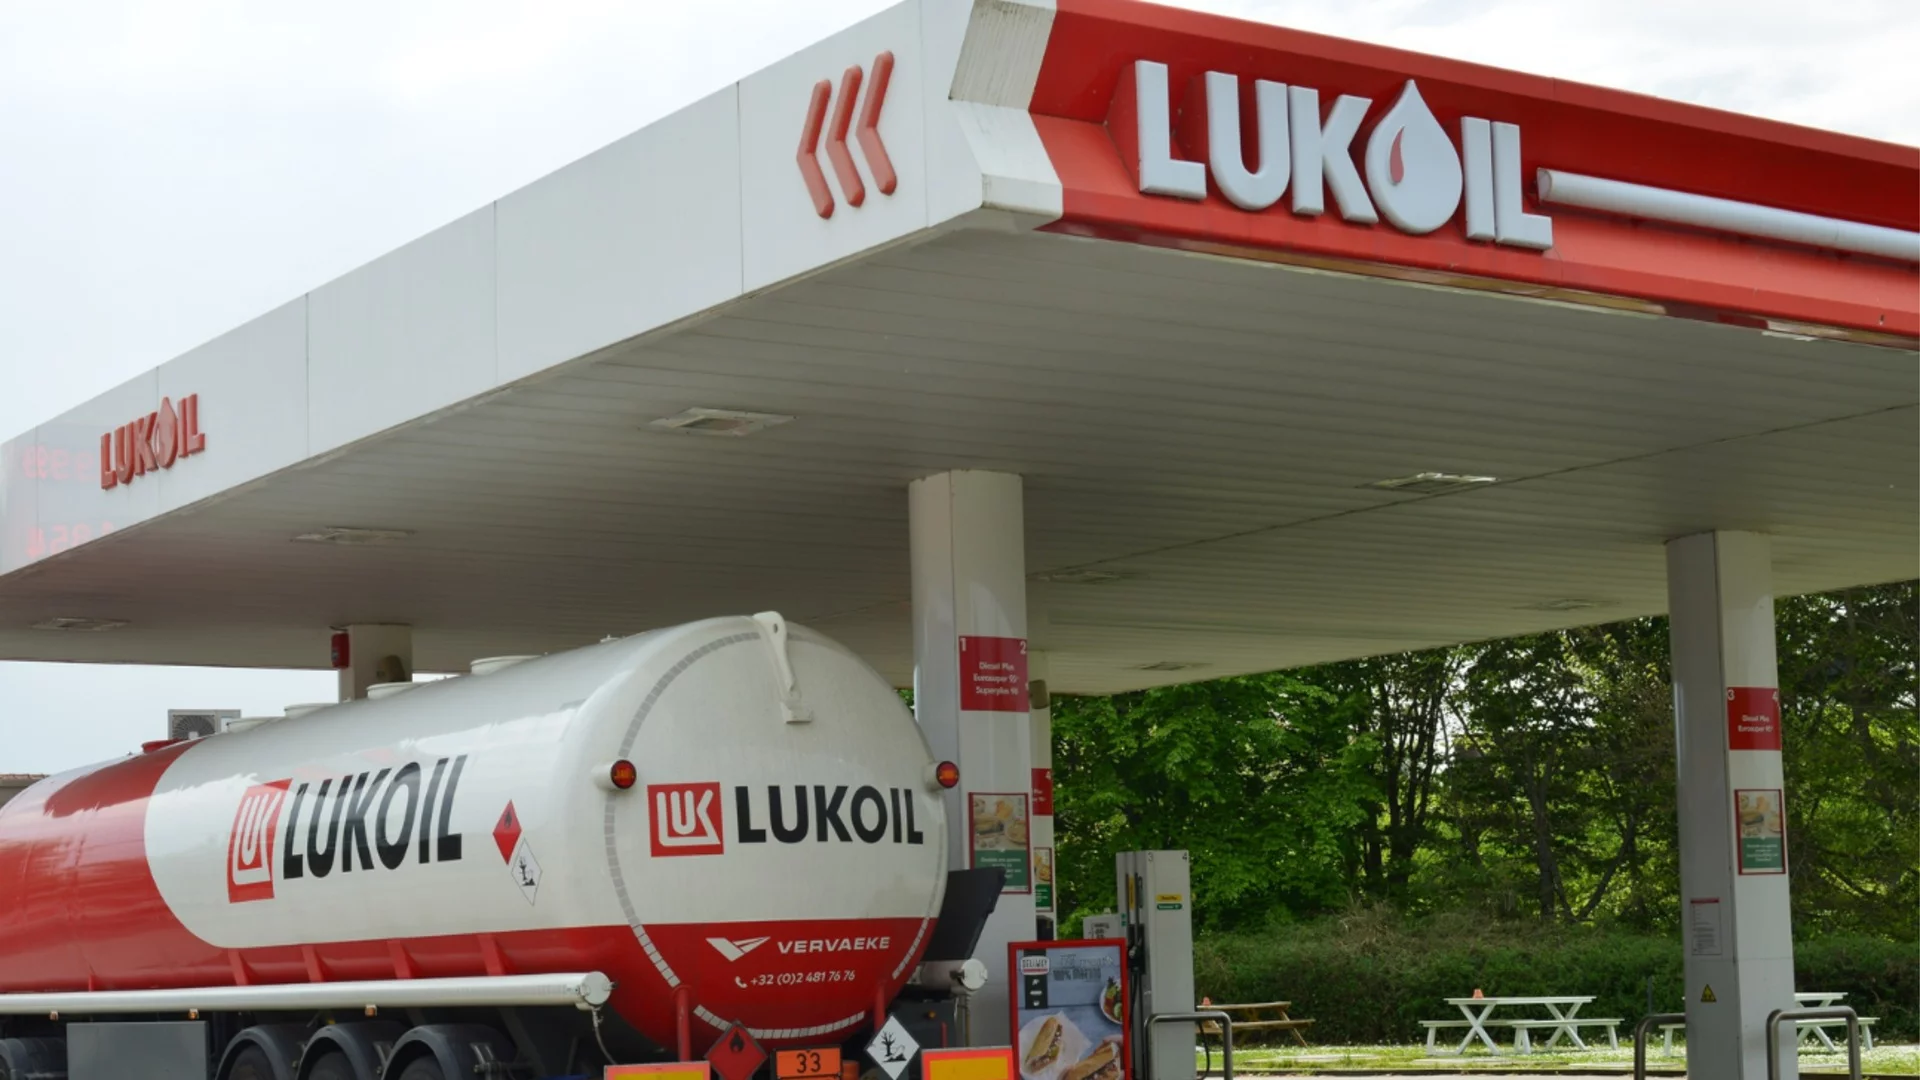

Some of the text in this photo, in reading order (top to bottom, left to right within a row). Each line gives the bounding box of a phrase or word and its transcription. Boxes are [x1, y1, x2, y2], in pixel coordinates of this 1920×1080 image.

[1135, 60, 1553, 251] LUKOIL
[101, 393, 206, 491] LUKOIL
[961, 638, 1027, 655] 1 2
[1727, 689, 1735, 701] 3
[283, 754, 468, 880] LUKOIL
[656, 785, 924, 847] LUK LUKOIL
[777, 936, 891, 955] VERVAEKE
[750, 970, 856, 986] +32 (0)2 481 76 76
[796, 1052, 822, 1074] 33
